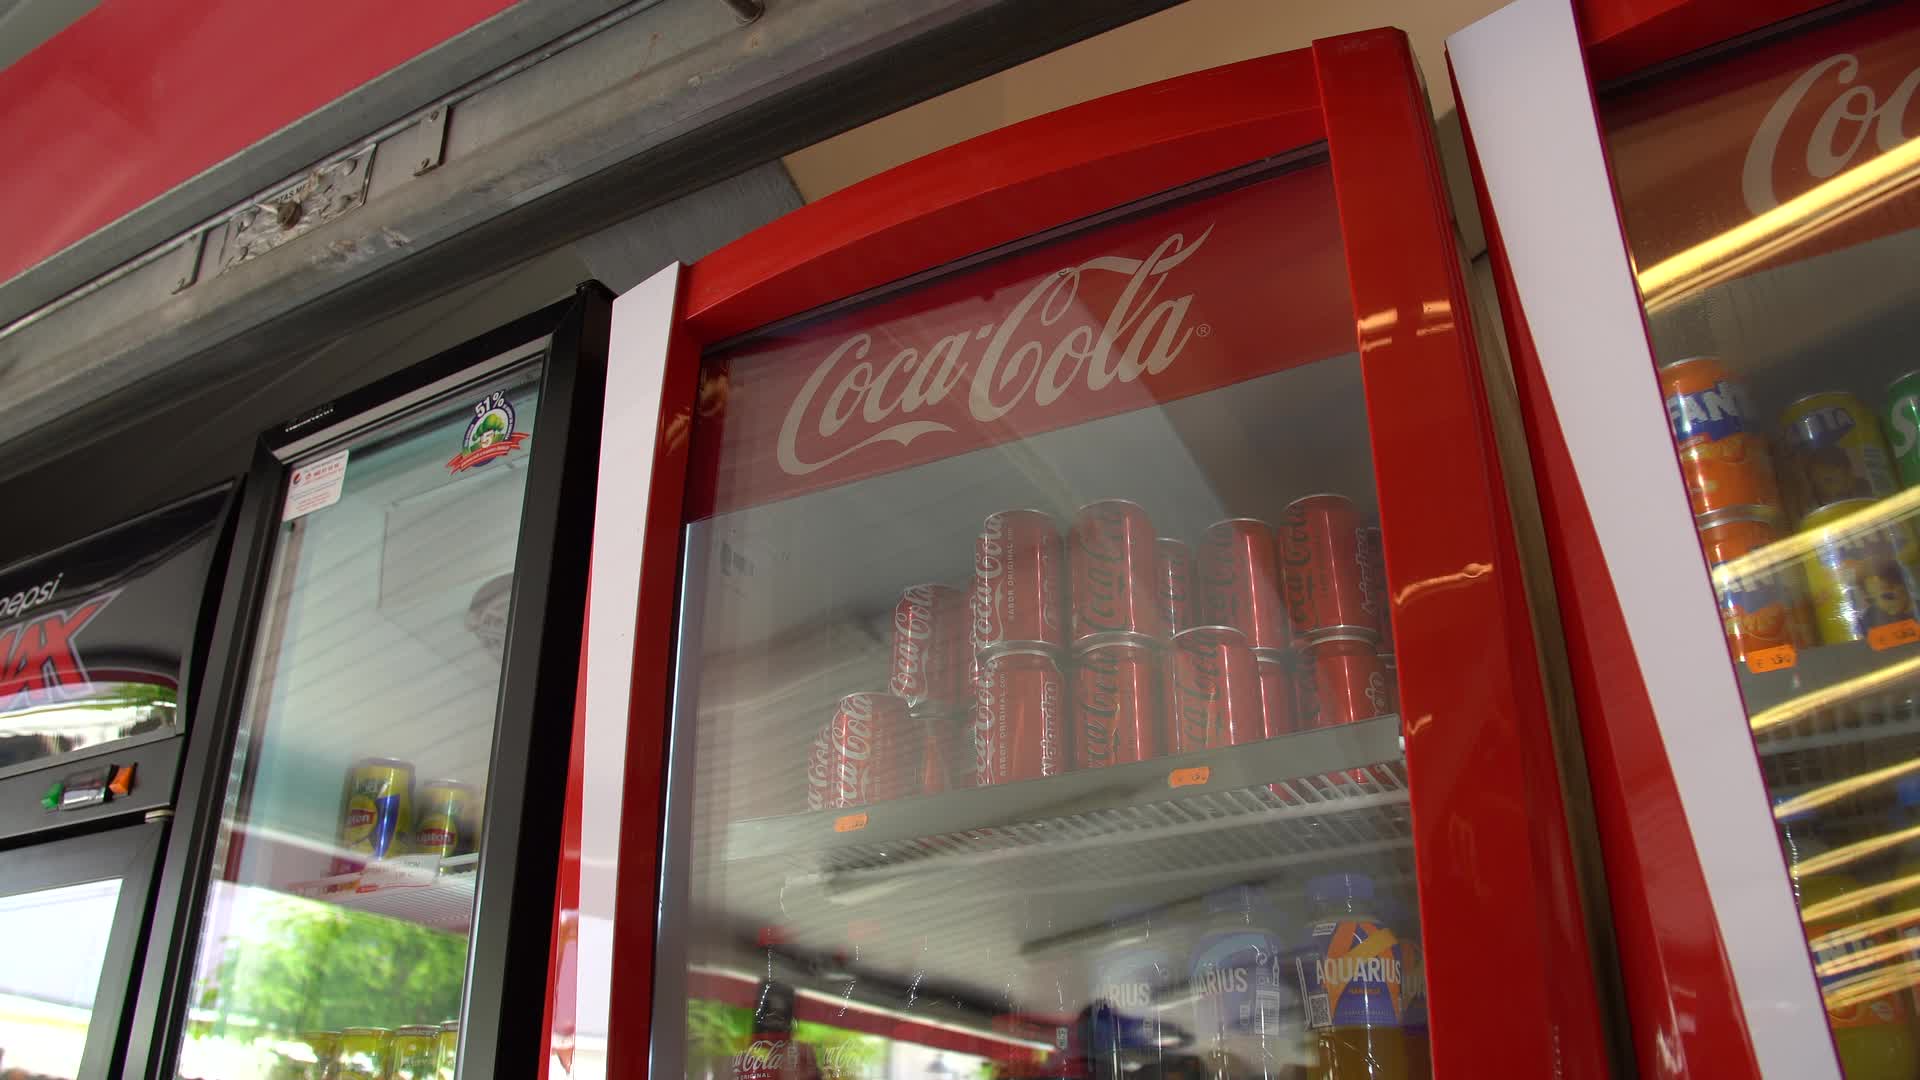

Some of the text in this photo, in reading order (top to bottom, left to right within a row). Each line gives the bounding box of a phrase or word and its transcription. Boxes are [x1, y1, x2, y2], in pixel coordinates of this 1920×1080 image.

[777, 221, 1215, 475] Coca-Cola
[474, 390, 506, 418] 51%
[1316, 956, 1401, 984] AQUARIUS
